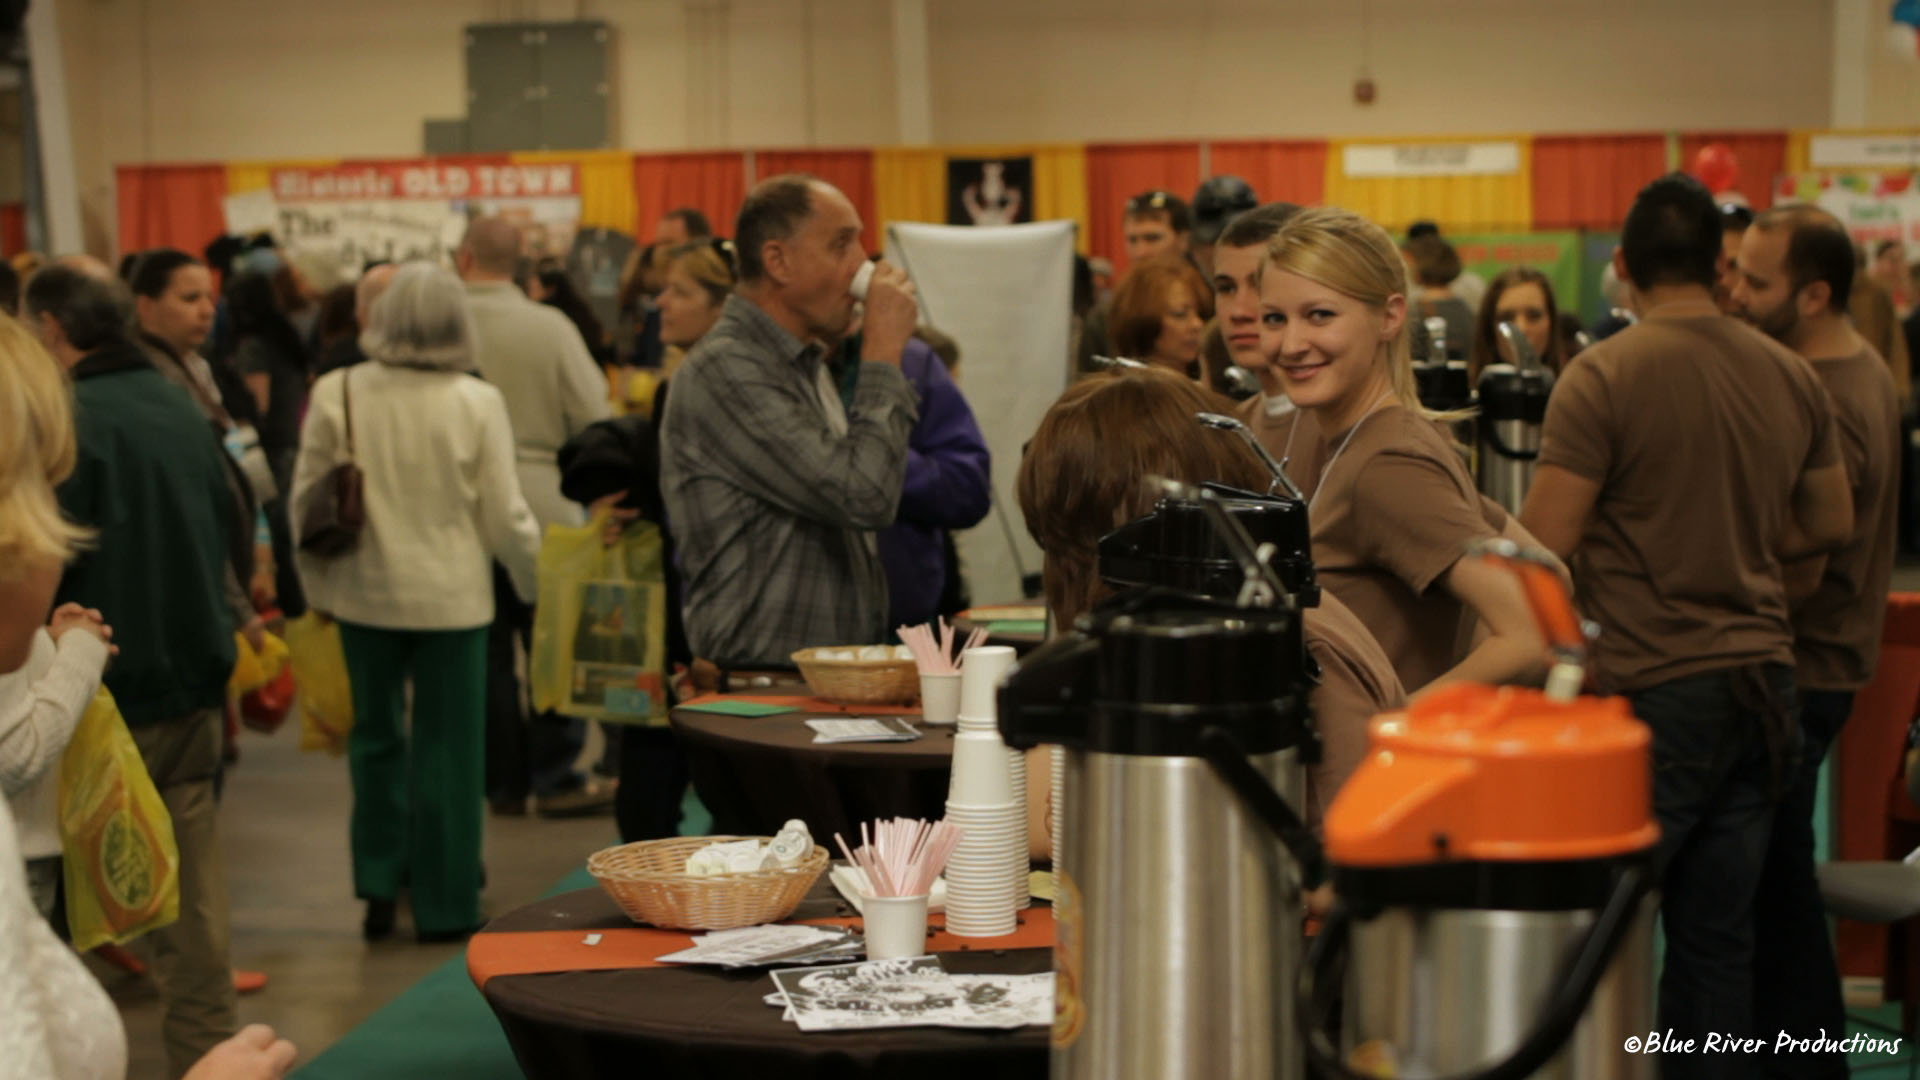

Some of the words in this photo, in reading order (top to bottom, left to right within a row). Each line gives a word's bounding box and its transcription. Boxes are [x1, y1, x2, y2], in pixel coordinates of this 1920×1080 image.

[278, 168, 394, 197] Historic
[402, 166, 470, 195] OLD
[478, 164, 572, 193] TOWN
[279, 209, 333, 237] The
